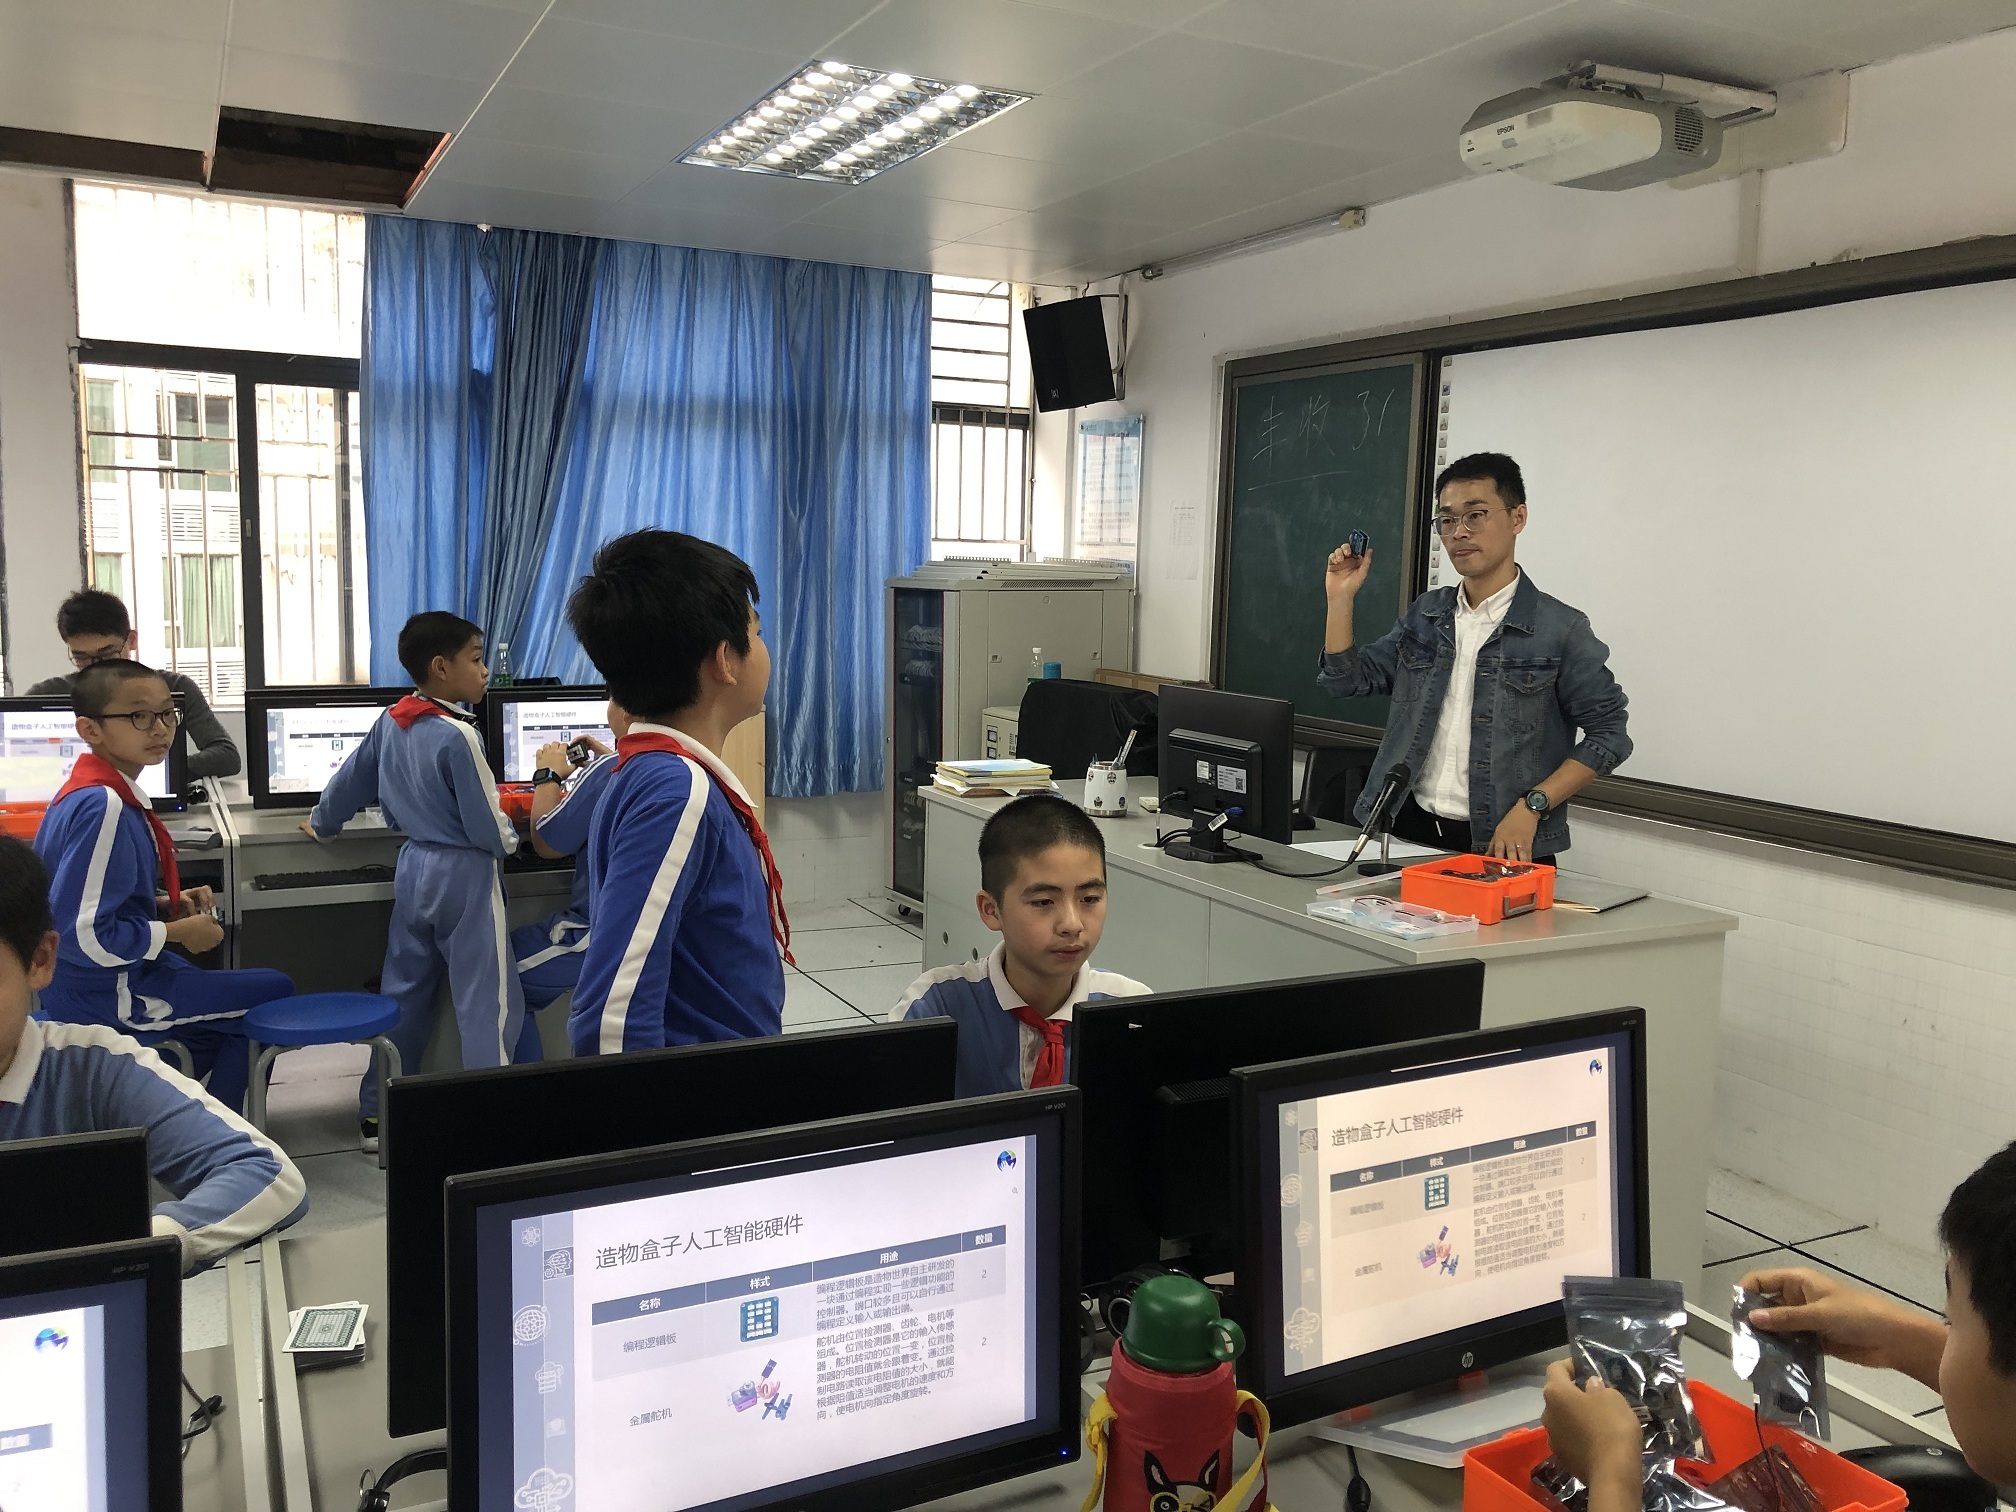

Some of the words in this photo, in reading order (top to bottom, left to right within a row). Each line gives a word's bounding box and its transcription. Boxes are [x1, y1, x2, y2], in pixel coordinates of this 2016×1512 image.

[1496, 124, 1515, 136] EPSON
[1331, 1106, 1464, 1147] 造物盒子人工智能硬件
[596, 1213, 804, 1270] 造物盒子人工智能硬件
[638, 1297, 661, 1312] 名称
[749, 1275, 771, 1290] 样式
[879, 1250, 899, 1264] 用途
[974, 1232, 993, 1246] 数量
[816, 1259, 955, 1295] 编程逻辑板是造物世界自主研发的
[981, 1269, 987, 1279] 2
[816, 1270, 955, 1305] 一块通过编程实现一些逻辑功能的
[623, 1332, 677, 1353] 编程逻辑板
[981, 1336, 987, 1347] 2
[629, 1407, 673, 1428] 金属舵机
